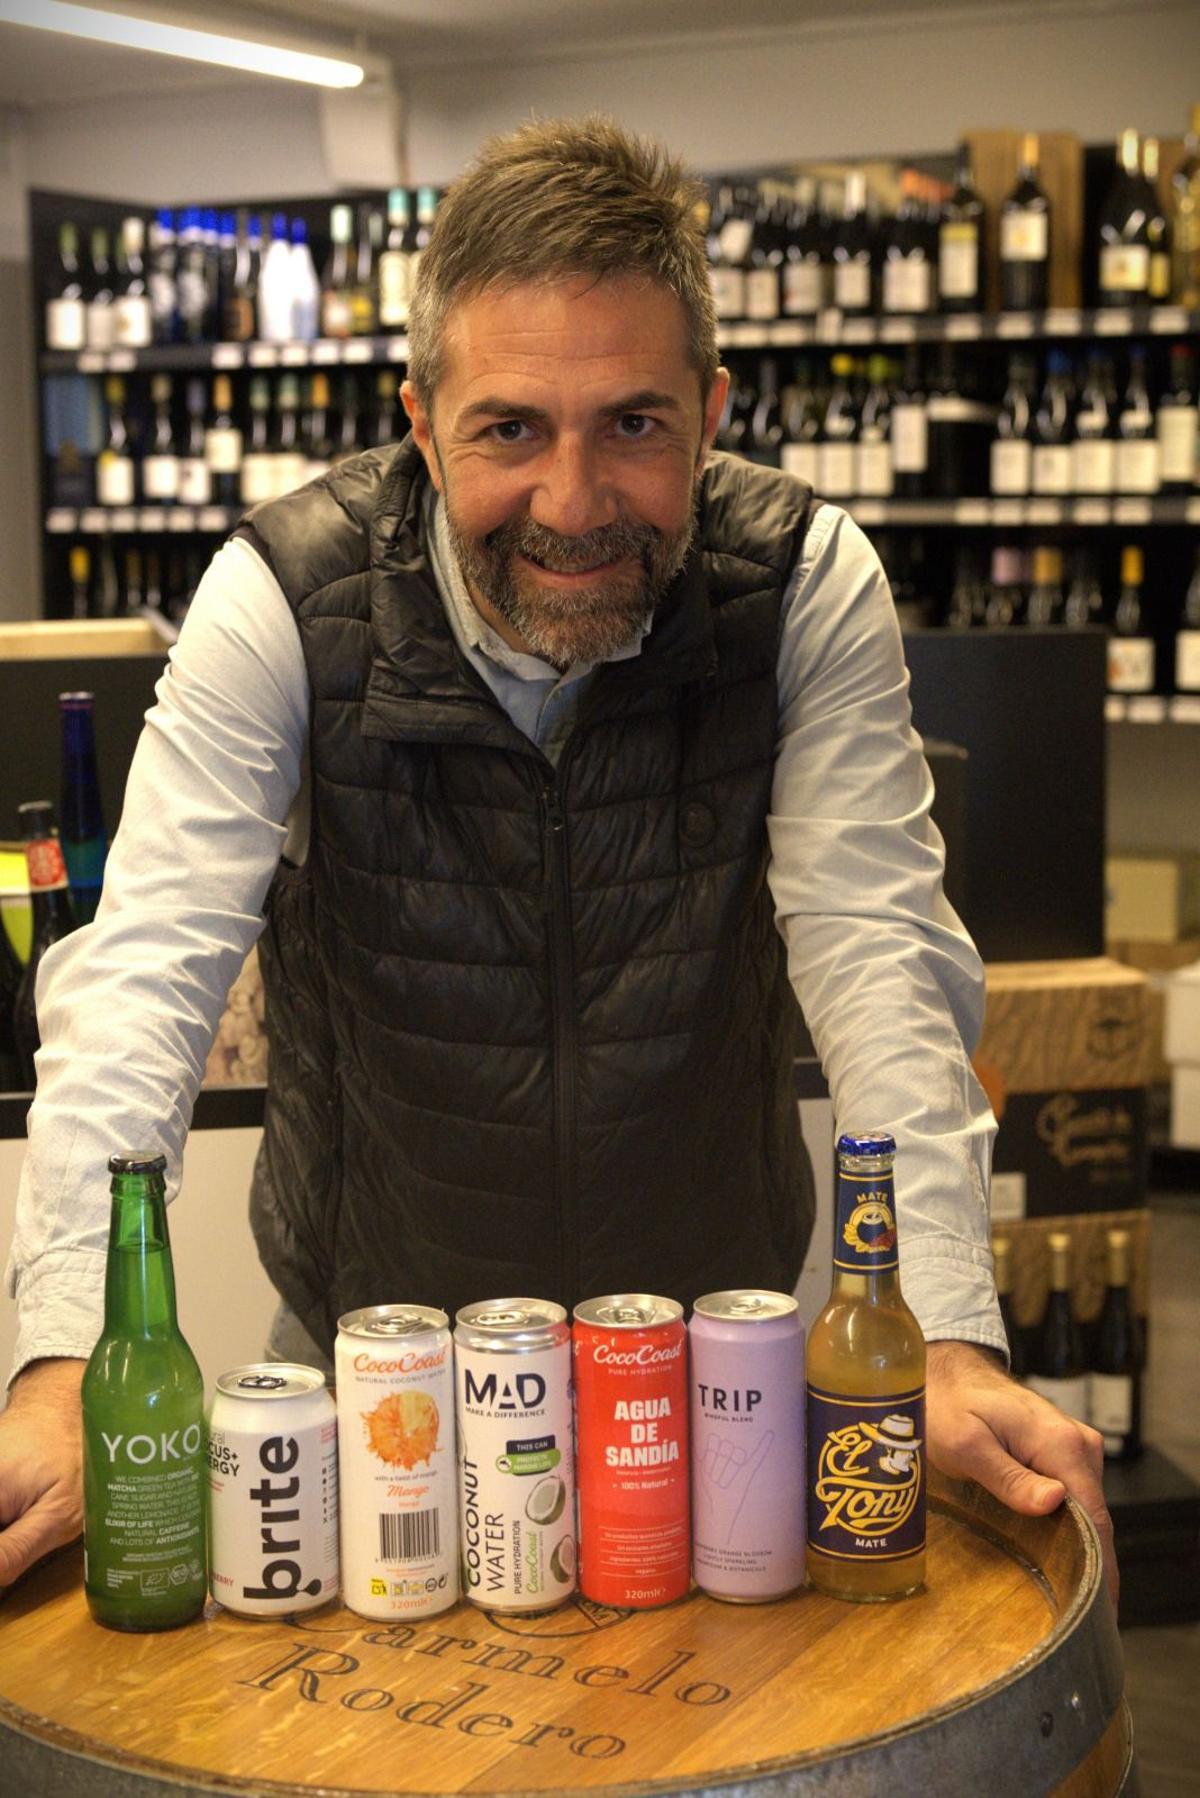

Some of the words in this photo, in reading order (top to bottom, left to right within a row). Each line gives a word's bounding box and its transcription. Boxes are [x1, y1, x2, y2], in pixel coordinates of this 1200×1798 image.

[856, 1192, 888, 1203] MATE
[353, 1344, 448, 1373] CocoCoast
[593, 1338, 683, 1364] CocoCoast
[608, 1367, 627, 1375] PURE
[464, 1368, 546, 1409] MAD
[698, 1384, 762, 1412] TRIP
[465, 1406, 483, 1416] MAKE
[494, 1408, 546, 1419] DIFFERENCE
[614, 1397, 672, 1421] AGUA
[101, 1423, 200, 1465] YOKO
[516, 1443, 534, 1452] THIS
[534, 1440, 548, 1449] CAN
[630, 1422, 658, 1444] DE
[605, 1439, 679, 1468] SANDÍA
[107, 1483, 137, 1493] MATCHA
[386, 1484, 430, 1498] Mango
[641, 1479, 669, 1489] Natural
[816, 1472, 916, 1532] Tony
[137, 1520, 154, 1529] LIFE
[464, 1456, 481, 1587] COCONUT
[484, 1513, 505, 1591] WATER
[512, 1520, 522, 1569] HYDRATION
[855, 1538, 888, 1548] MATE
[525, 1530, 539, 1594] CocoCoast
[514, 1570, 522, 1594] PURE
[290, 1618, 731, 1706] armelo
[236, 1643, 626, 1759] Rodero
